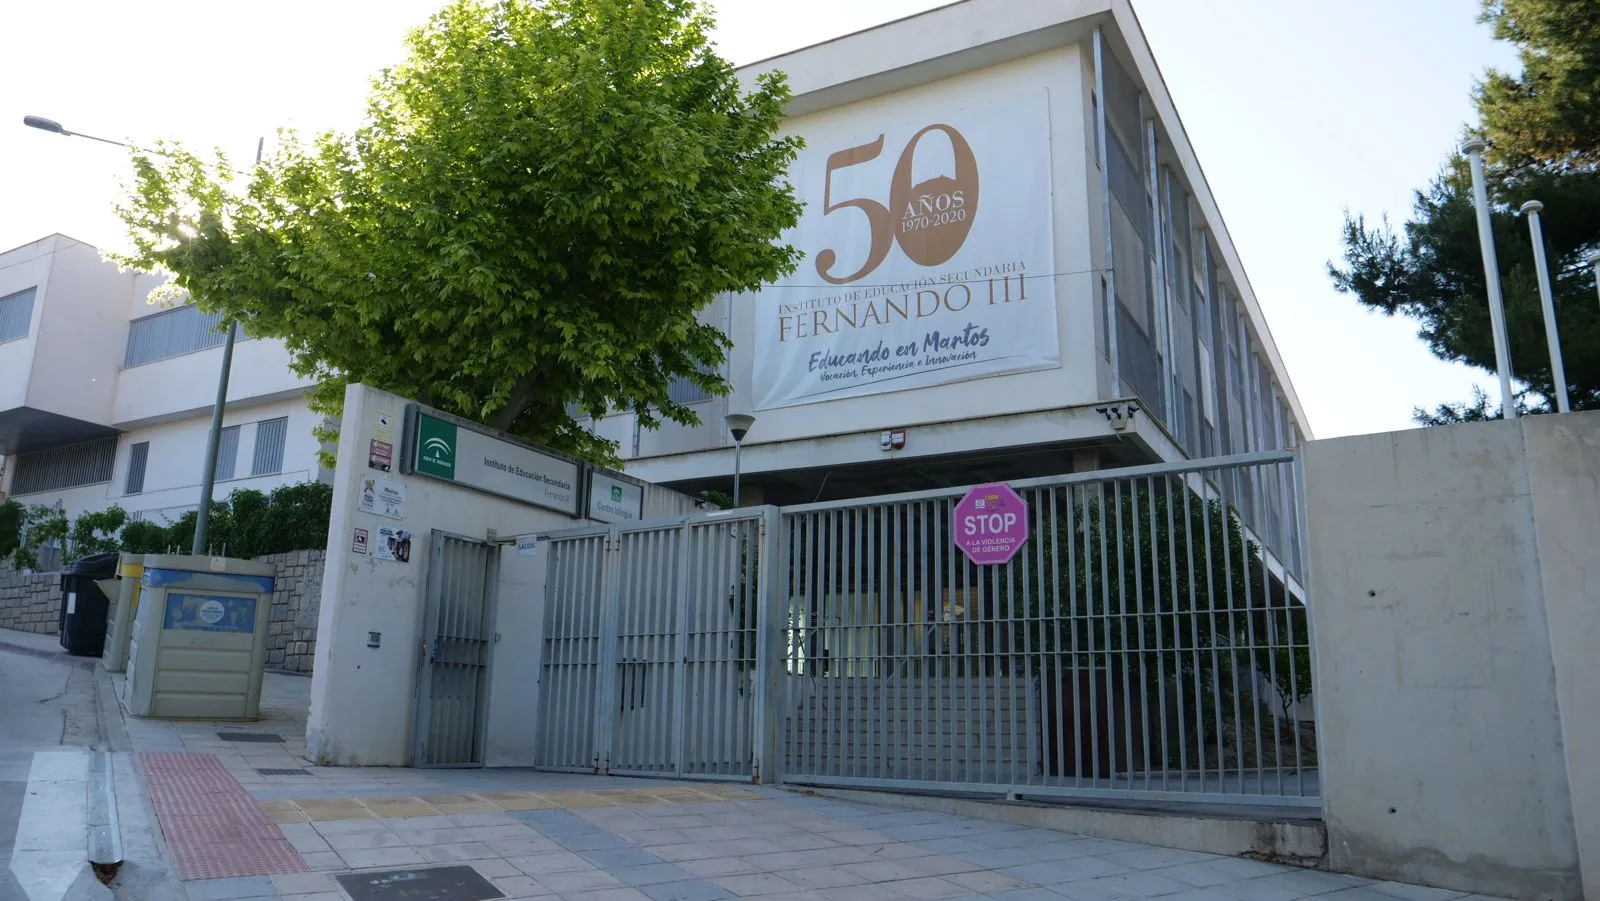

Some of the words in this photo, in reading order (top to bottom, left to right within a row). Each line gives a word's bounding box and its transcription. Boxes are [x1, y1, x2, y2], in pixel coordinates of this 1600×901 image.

[815, 123, 979, 285] 50
[902, 190, 964, 219] AÑOS
[902, 209, 966, 233] 1970-2020
[778, 295, 841, 314] INSTITUTO
[844, 290, 861, 302] DE
[865, 275, 937, 299] EDUCACIÓN
[939, 260, 1026, 283] SECUNDARIA
[778, 284, 972, 342] FERNANDO
[988, 273, 1030, 305] III
[808, 340, 890, 372] Educando
[896, 342, 918, 357] en
[923, 322, 990, 352] Martos
[484, 457, 507, 473] Instituto
[507, 464, 515, 474] de
[543, 475, 571, 491] Secundaria
[964, 512, 1016, 536] STOP
[981, 537, 1016, 545] VIOLENCIA
